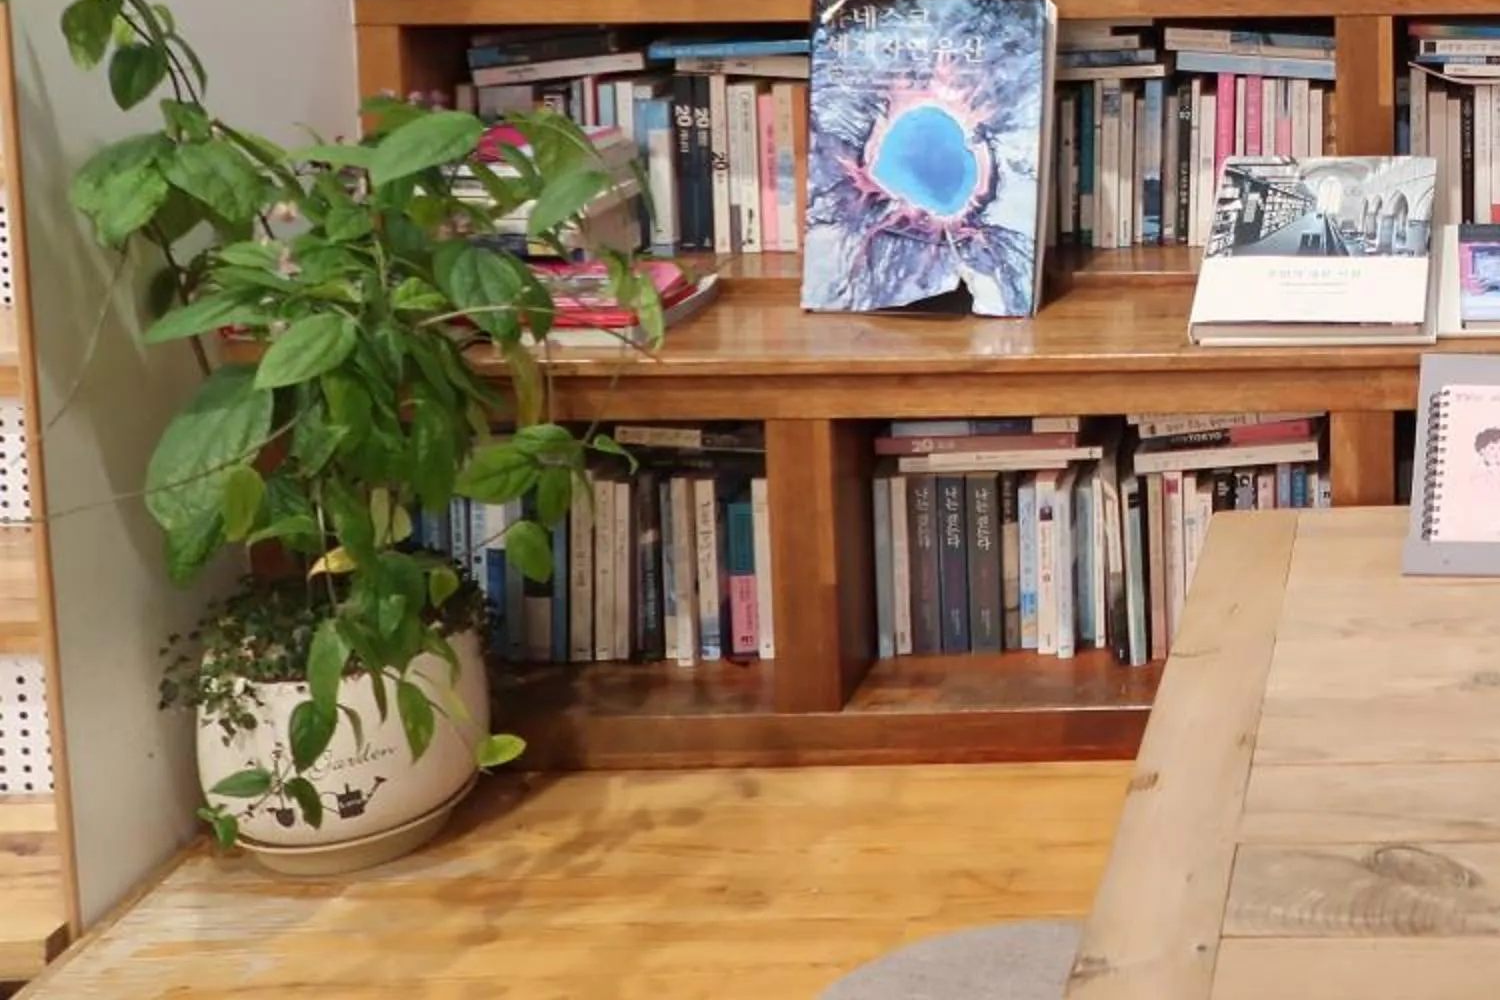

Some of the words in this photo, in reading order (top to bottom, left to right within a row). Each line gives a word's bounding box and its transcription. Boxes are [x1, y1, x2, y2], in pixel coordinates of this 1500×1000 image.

[827, 32, 986, 64] 세계자연유산
[674, 104, 693, 128] 20
[694, 107, 710, 129] 20
[711, 151, 730, 171] 20
[911, 437, 934, 453] 20
